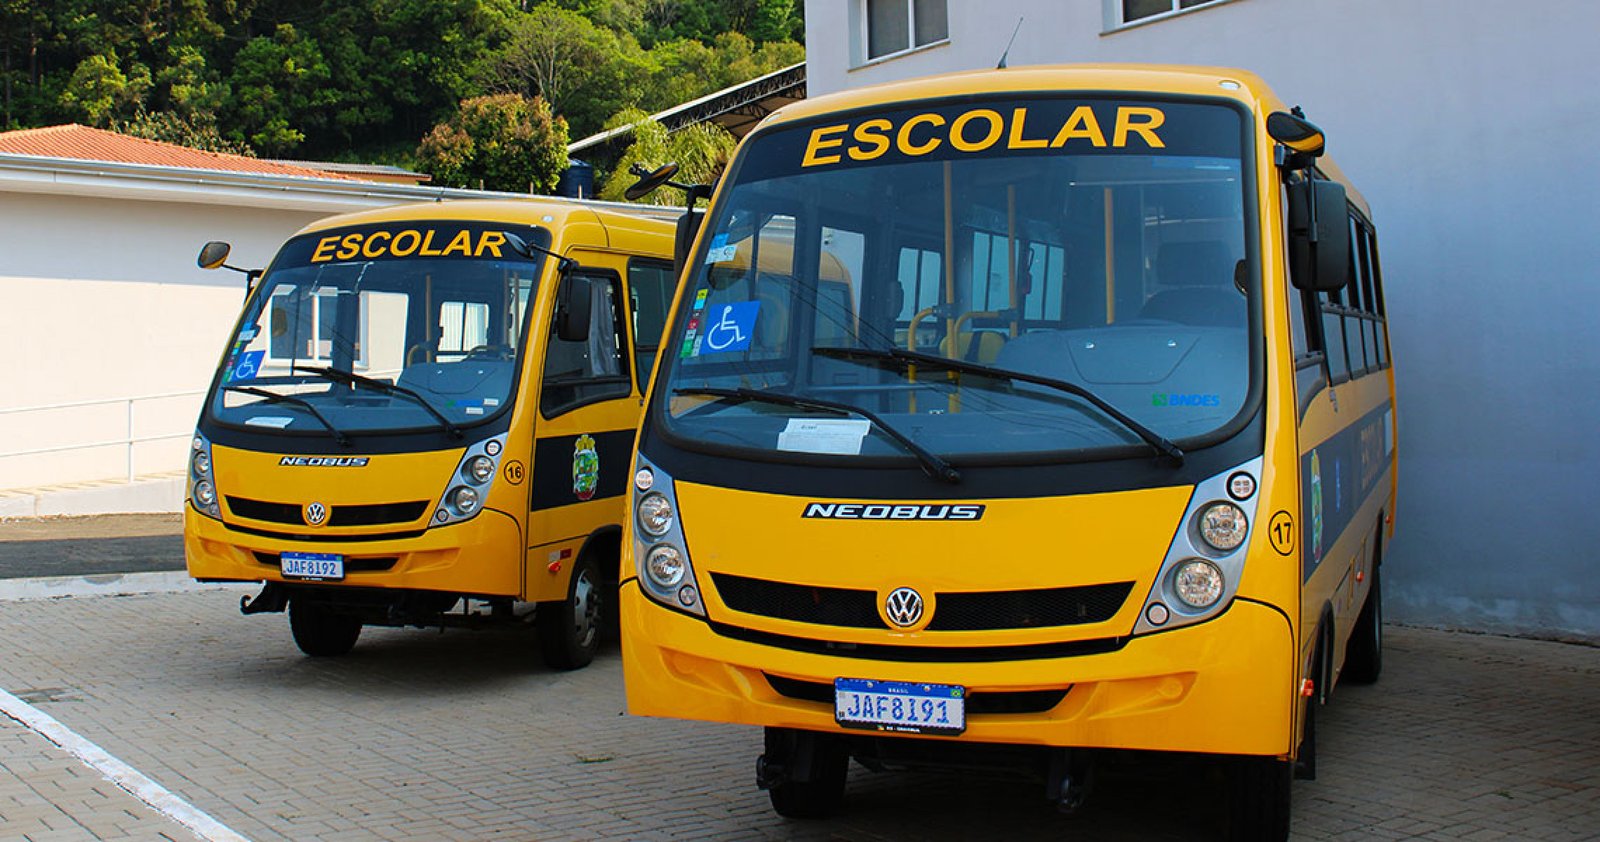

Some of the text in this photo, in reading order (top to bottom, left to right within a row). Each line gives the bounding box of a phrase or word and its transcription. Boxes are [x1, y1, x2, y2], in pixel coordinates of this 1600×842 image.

[801, 105, 1166, 168] ESCOLAR
[310, 229, 506, 263] ESCOLAR
[1168, 393, 1220, 407] BNDES
[280, 457, 368, 466] NEOBUS
[507, 466, 521, 479] 16
[806, 503, 981, 519] NEOBUS
[1274, 522, 1291, 544] 17
